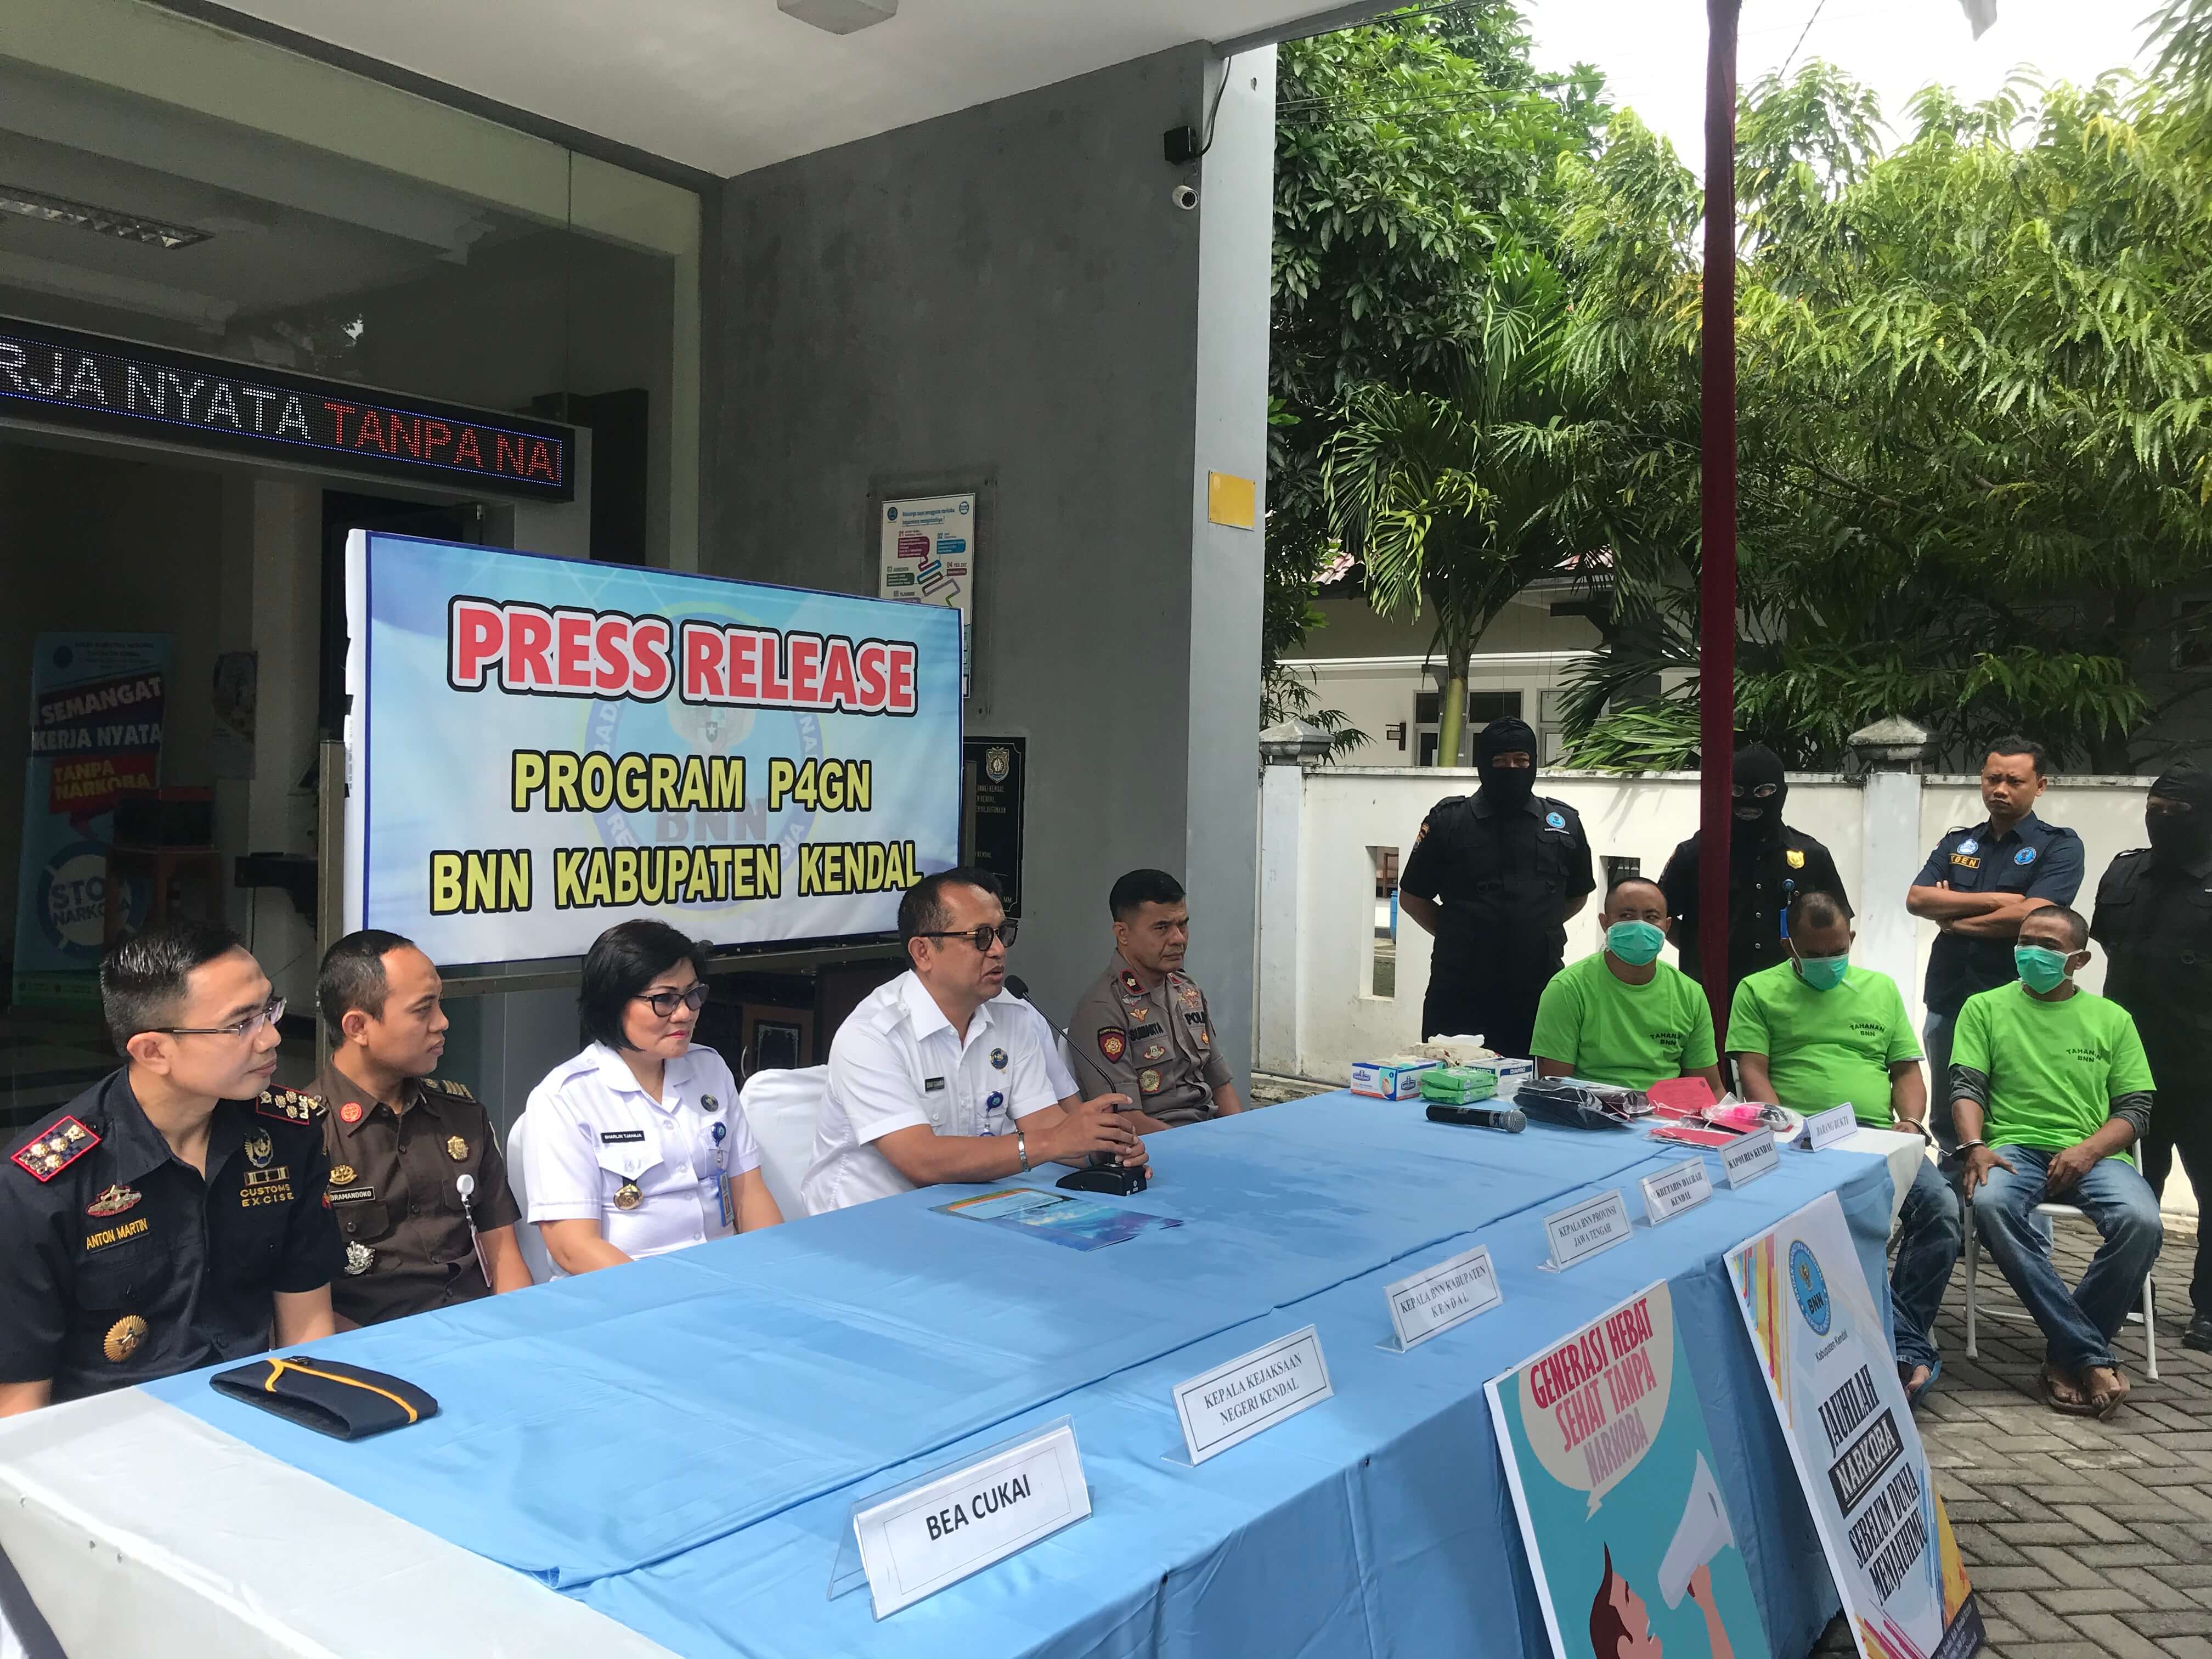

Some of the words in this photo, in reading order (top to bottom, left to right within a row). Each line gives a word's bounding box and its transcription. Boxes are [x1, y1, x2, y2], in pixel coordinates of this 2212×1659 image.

[126, 365, 311, 440] NYATA
[324, 401, 483, 469] TANPA
[497, 433, 560, 481] NA
[450, 598, 671, 701] PRESS
[682, 623, 917, 715] RELEASE
[41, 676, 162, 725] SEMANGAT
[33, 728, 92, 751] KERJA
[97, 724, 162, 746] NYATA
[53, 760, 115, 782] TANPA
[55, 773, 150, 800] NARKOBA
[512, 750, 744, 812] PROGRAM
[769, 759, 871, 812] P4GN
[52, 876, 106, 910] STO
[431, 850, 532, 916] BNN
[554, 845, 783, 910] KABUPATEN
[799, 840, 923, 898] KENDAL
[1849, 1023, 1885, 1032] TAHANAN
[1728, 1149, 1754, 1170] KAPOLRES
[1753, 1143, 1774, 1159] KENDAL
[240, 1183, 290, 1198] CUSTOMS
[241, 1193, 295, 1207] EXCISE
[1670, 1190, 1692, 1207] KENDAL
[86, 1229, 116, 1250] ANTON
[116, 1217, 148, 1239] MARTIN
[1558, 1220, 1582, 1238] KEPALA
[1581, 1216, 1593, 1228] BNN
[1592, 1205, 1617, 1223] PROVINSI
[1573, 1233, 1591, 1248] JAWA
[1589, 1222, 1612, 1240] TENGAH
[1400, 1291, 1431, 1314] KEPALA
[1430, 1284, 1446, 1300] BNN
[1444, 1264, 1486, 1292] KABUPATEN
[1431, 1292, 1469, 1318] KENDAL
[1807, 1291, 1824, 1314] BNN
[1530, 1325, 1609, 1409] GENERASI
[1605, 1298, 1654, 1361] HEBAT
[1815, 1340, 1836, 1363] Kabupaten
[1834, 1329, 1848, 1346] Kendal
[1204, 1380, 1246, 1409] KEPALA
[1245, 1352, 1302, 1389] KEJAKSAAN
[1220, 1395, 1260, 1426] NEGERI
[1259, 1377, 1300, 1406] KENDAL
[1555, 1378, 1607, 1454] SEHAT
[1603, 1346, 1657, 1415] TANPA
[1818, 1363, 1880, 1459] JAUHILAH
[1583, 1406, 1649, 1488] NARKOBA
[1835, 1417, 1897, 1500] NARKOBA
[926, 1503, 969, 1541] BEA
[972, 1474, 1031, 1519] CUKAI
[1848, 1490, 1897, 1571] SEBELUM
[1886, 1461, 1921, 1522] DUNIA
[1868, 1506, 1928, 1606] MENJAUHIMU
